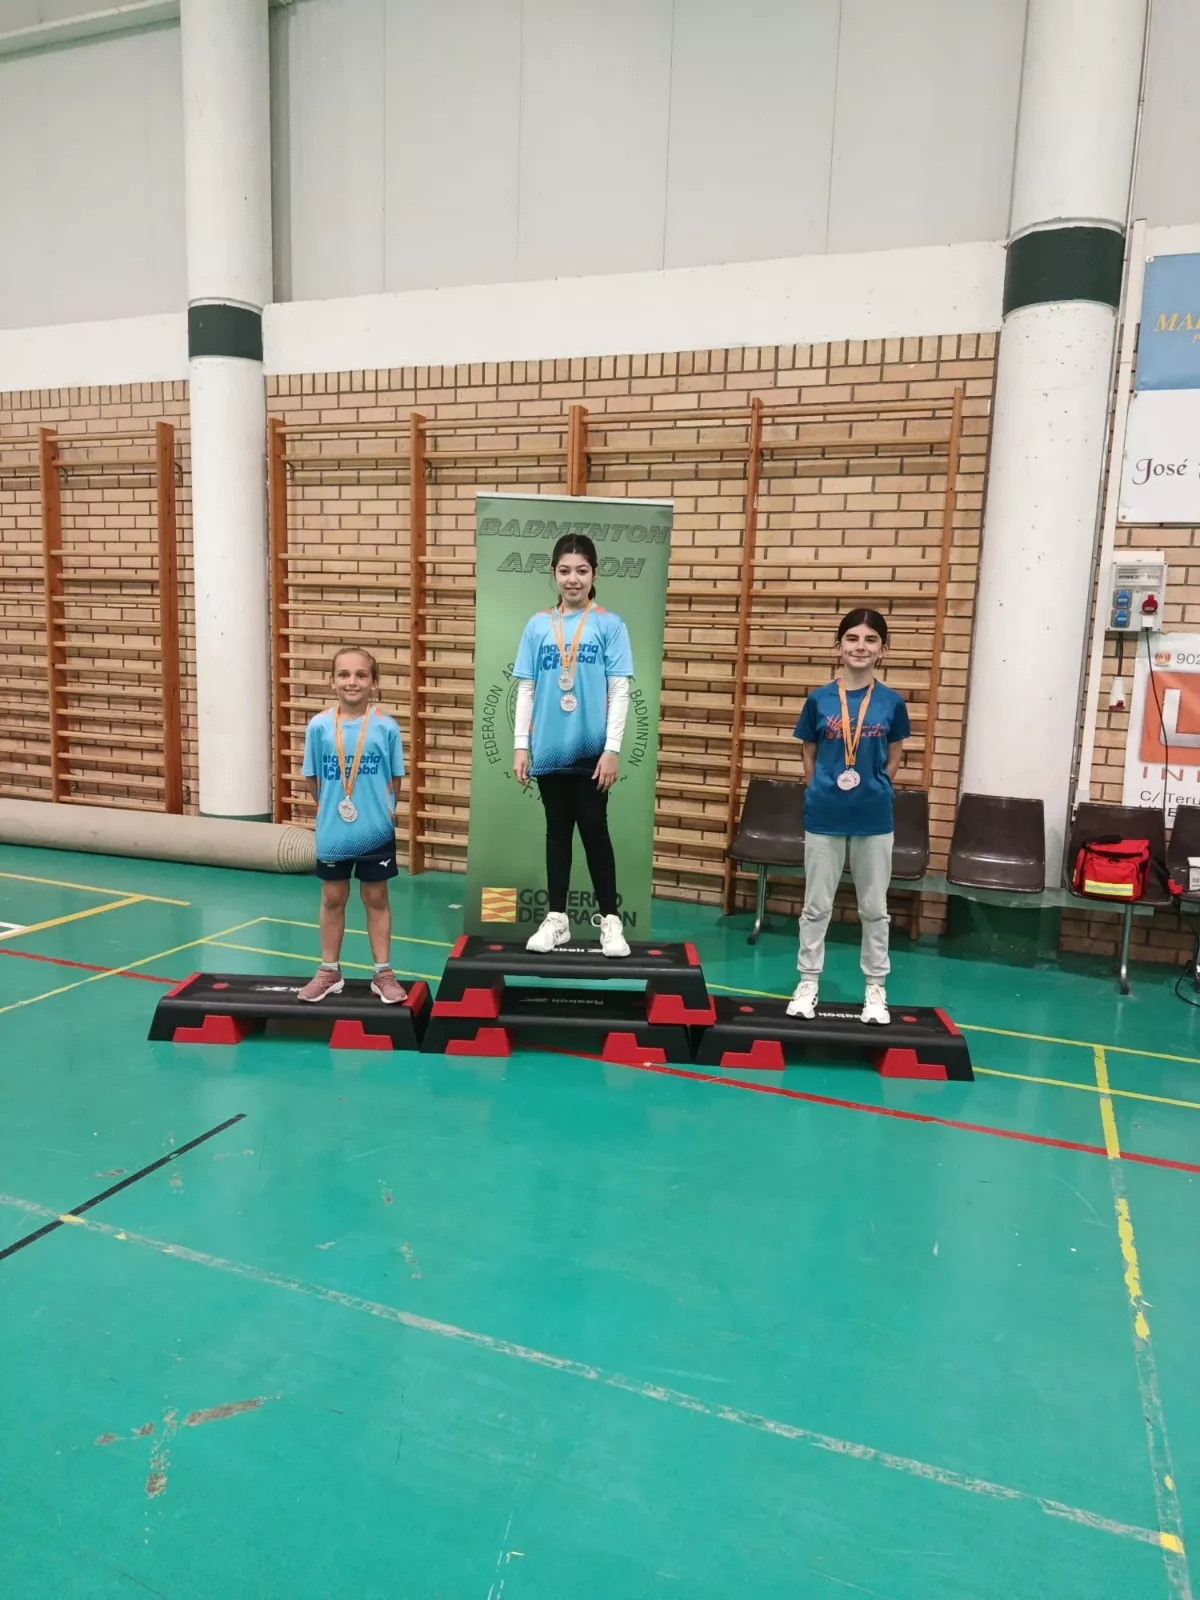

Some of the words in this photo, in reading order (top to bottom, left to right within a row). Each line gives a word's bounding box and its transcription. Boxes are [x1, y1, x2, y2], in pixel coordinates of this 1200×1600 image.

[1153, 312, 1200, 332] MA
[1132, 458, 1188, 485] José
[478, 517, 671, 544] BADMINTON
[497, 552, 647, 578] ARON
[482, 685, 503, 765] FEDERACION
[629, 690, 650, 768] BADMINTON
